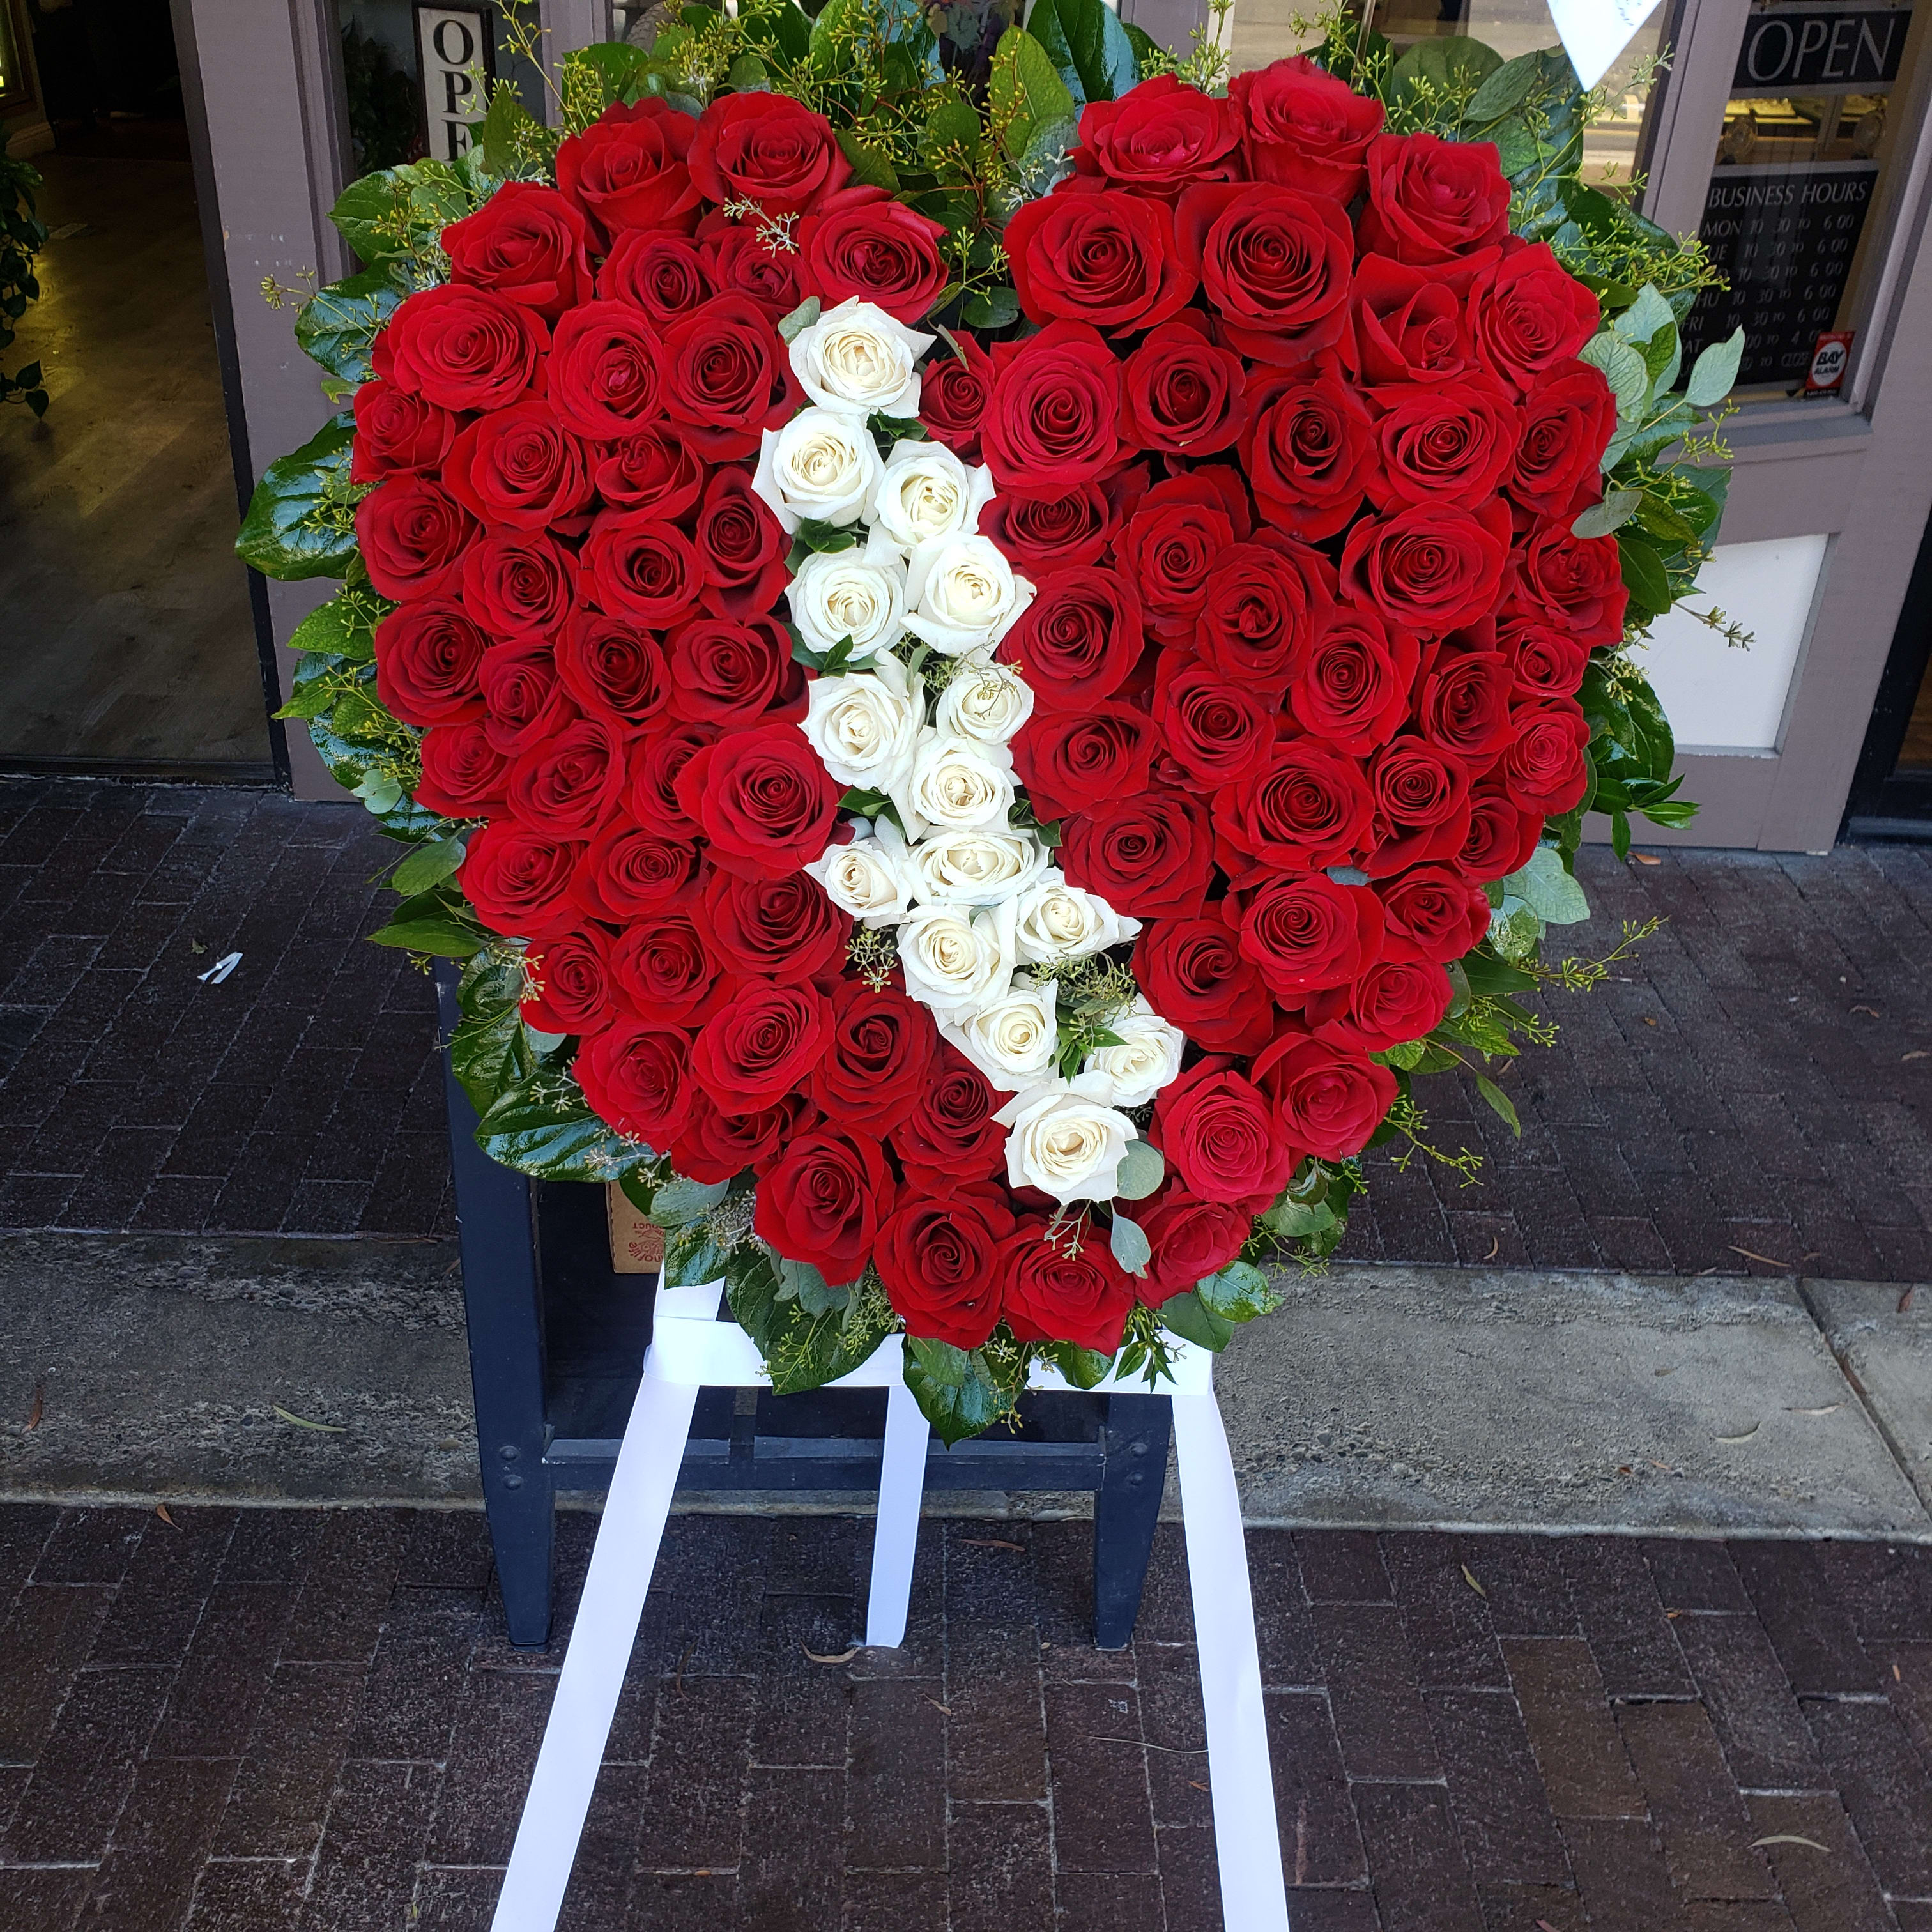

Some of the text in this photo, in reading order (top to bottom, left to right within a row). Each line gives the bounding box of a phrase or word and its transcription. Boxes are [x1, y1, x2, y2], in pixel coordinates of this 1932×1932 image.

[1748, 17, 1896, 81] OPEN
[1708, 181, 1868, 208] BUSINESS HOURS
[1702, 219, 1743, 237] MON
[1707, 243, 1728, 261] UE
[1695, 291, 1720, 309] HU
[1682, 337, 1703, 354] AT
[1816, 350, 1845, 365] BAY
[1813, 365, 1839, 376] ALARM
